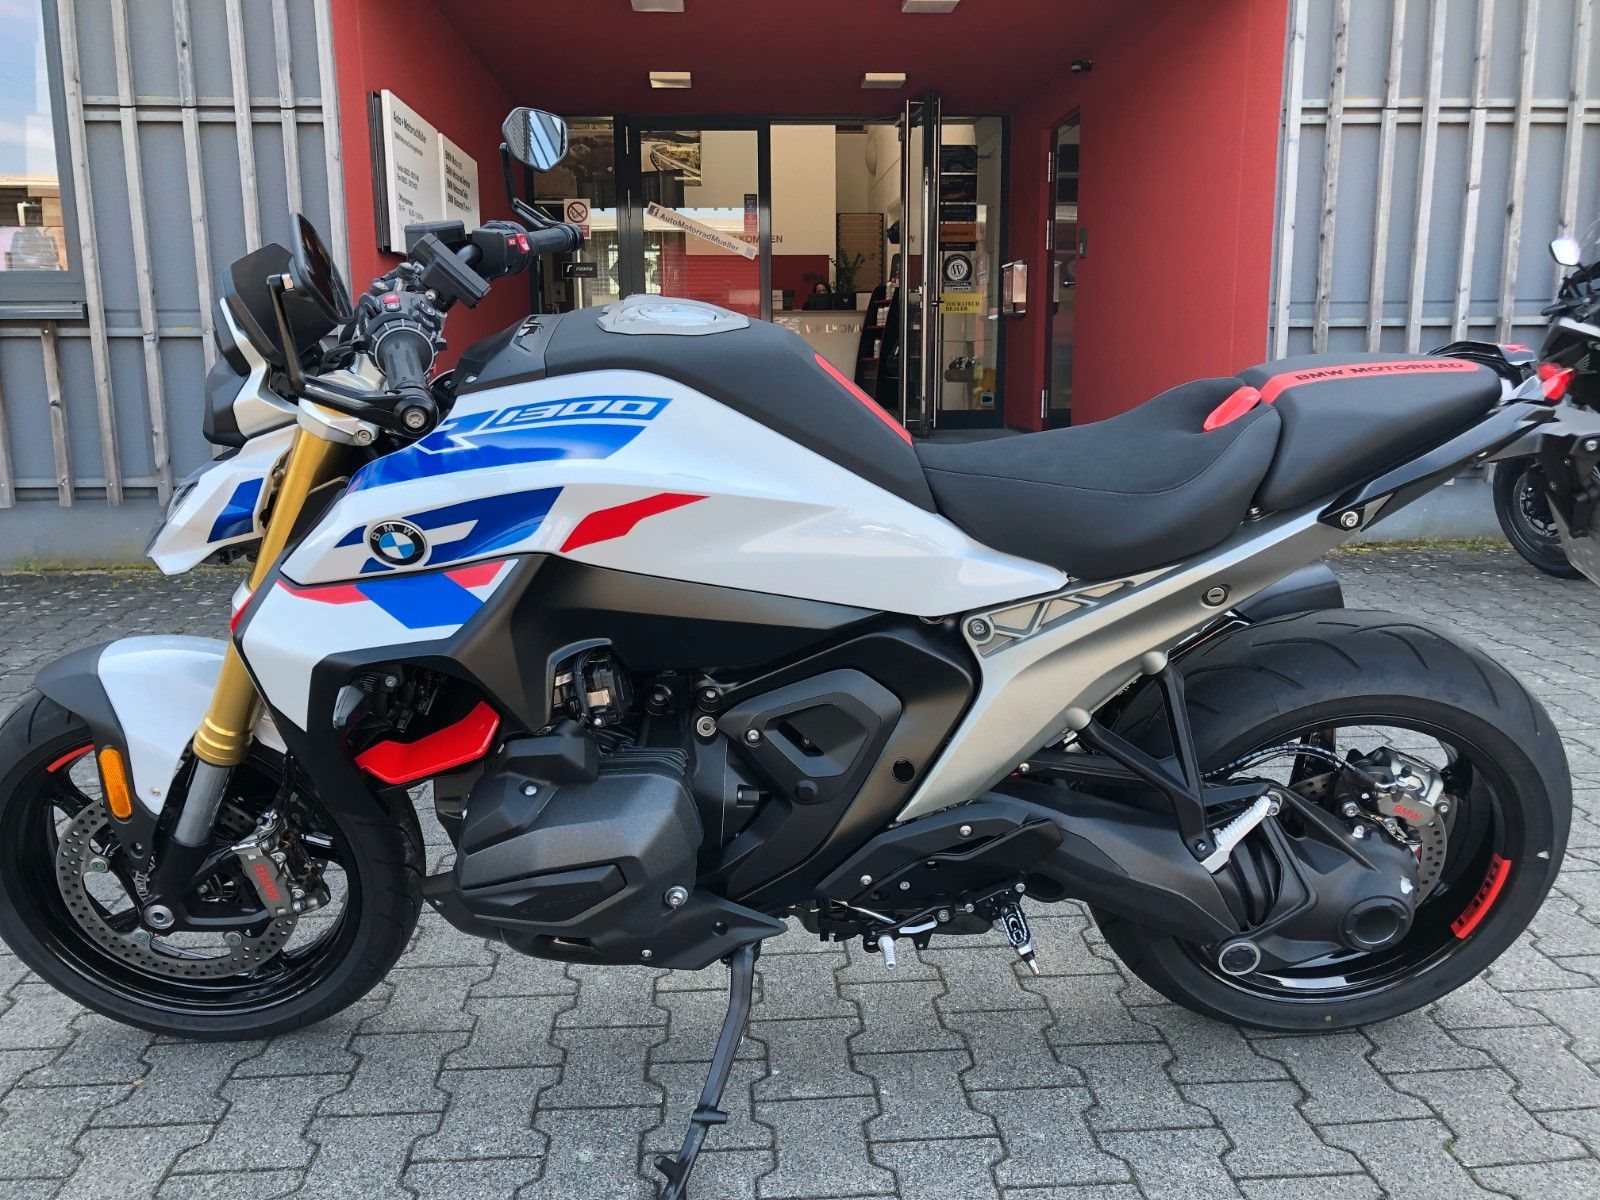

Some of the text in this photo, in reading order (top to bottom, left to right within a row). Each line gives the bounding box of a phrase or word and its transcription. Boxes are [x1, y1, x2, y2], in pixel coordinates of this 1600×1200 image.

[660, 213, 740, 252] AutoMotorradMueller
[1295, 363, 1464, 381] BMW MOTORRAD
[496, 399, 658, 425] 1300
[371, 523, 415, 542] BMW
[1392, 804, 1423, 821] BMW
[251, 864, 282, 901] BMW
